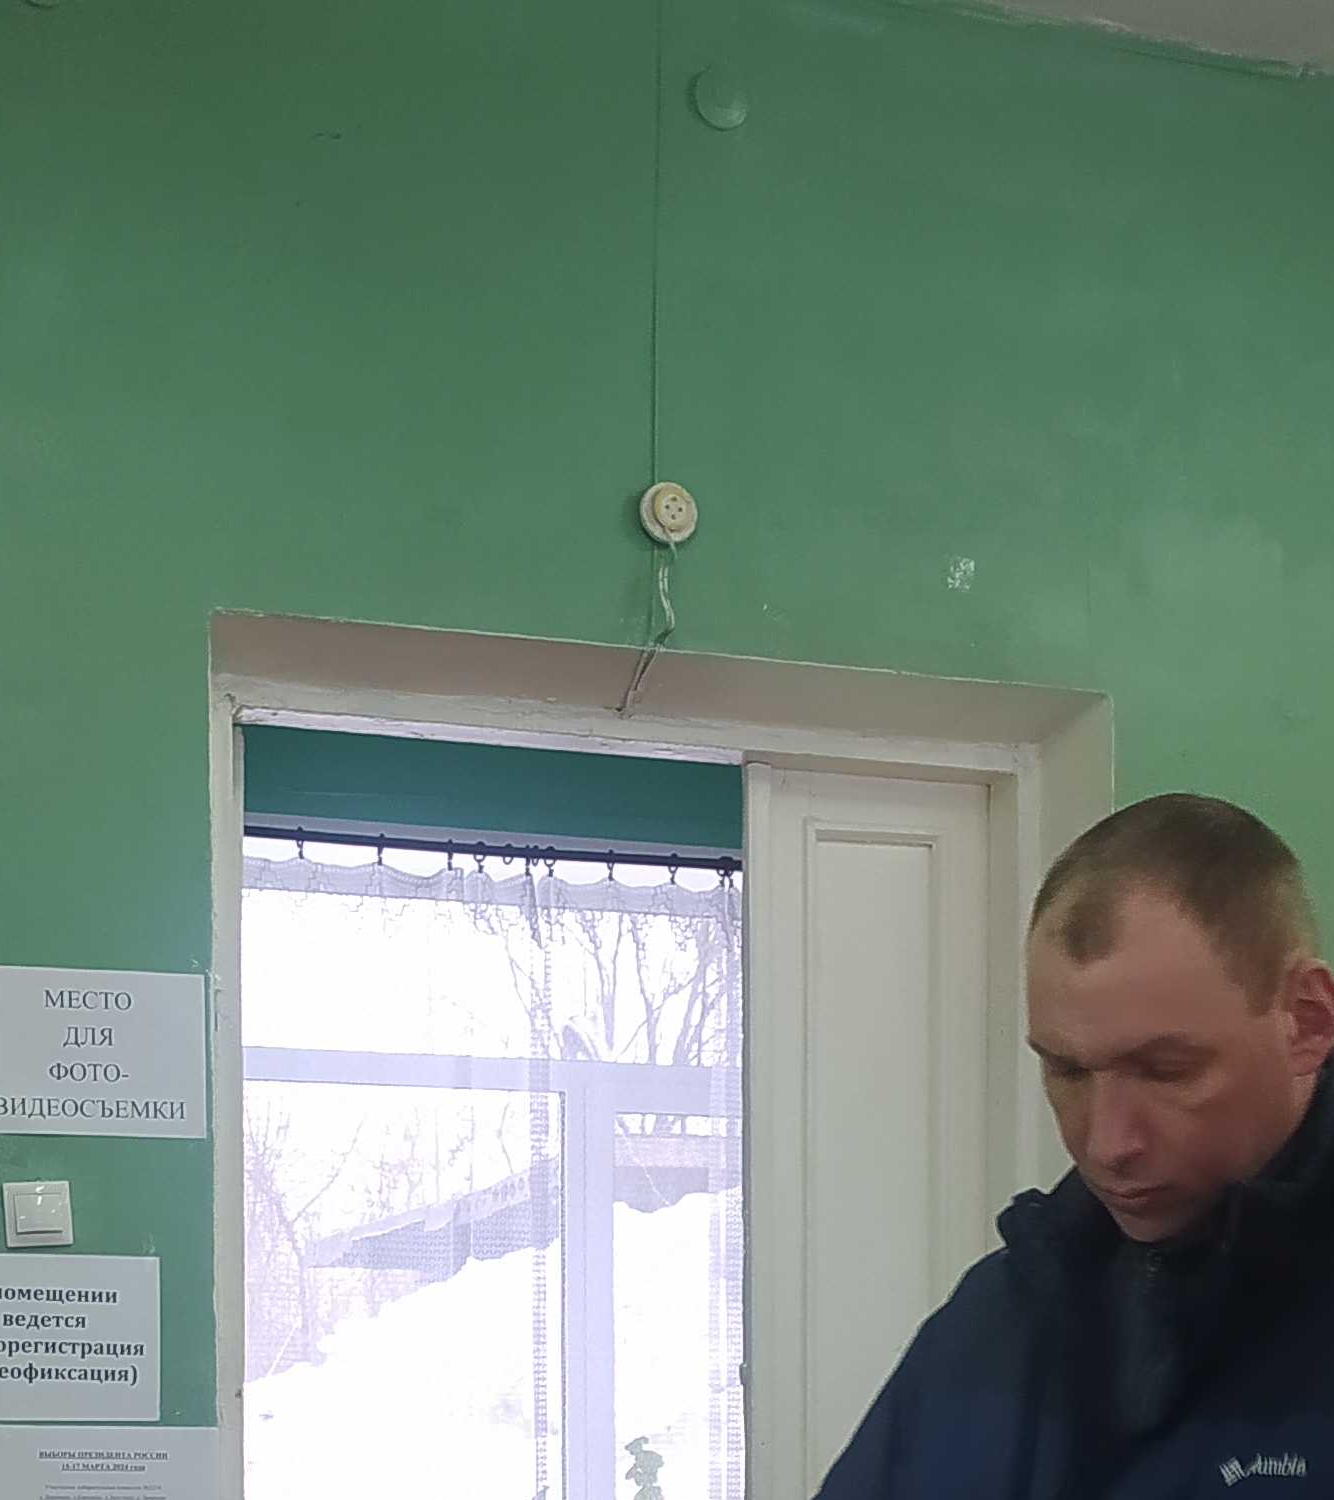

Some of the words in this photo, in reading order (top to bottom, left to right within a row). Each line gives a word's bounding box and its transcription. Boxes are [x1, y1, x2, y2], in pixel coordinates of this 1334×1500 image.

[43, 988, 133, 1012] МЕСТО
[62, 1026, 114, 1048] ДЛЯ
[48, 1062, 130, 1083] ФОТО-
[2, 1312, 87, 1330] ведется
